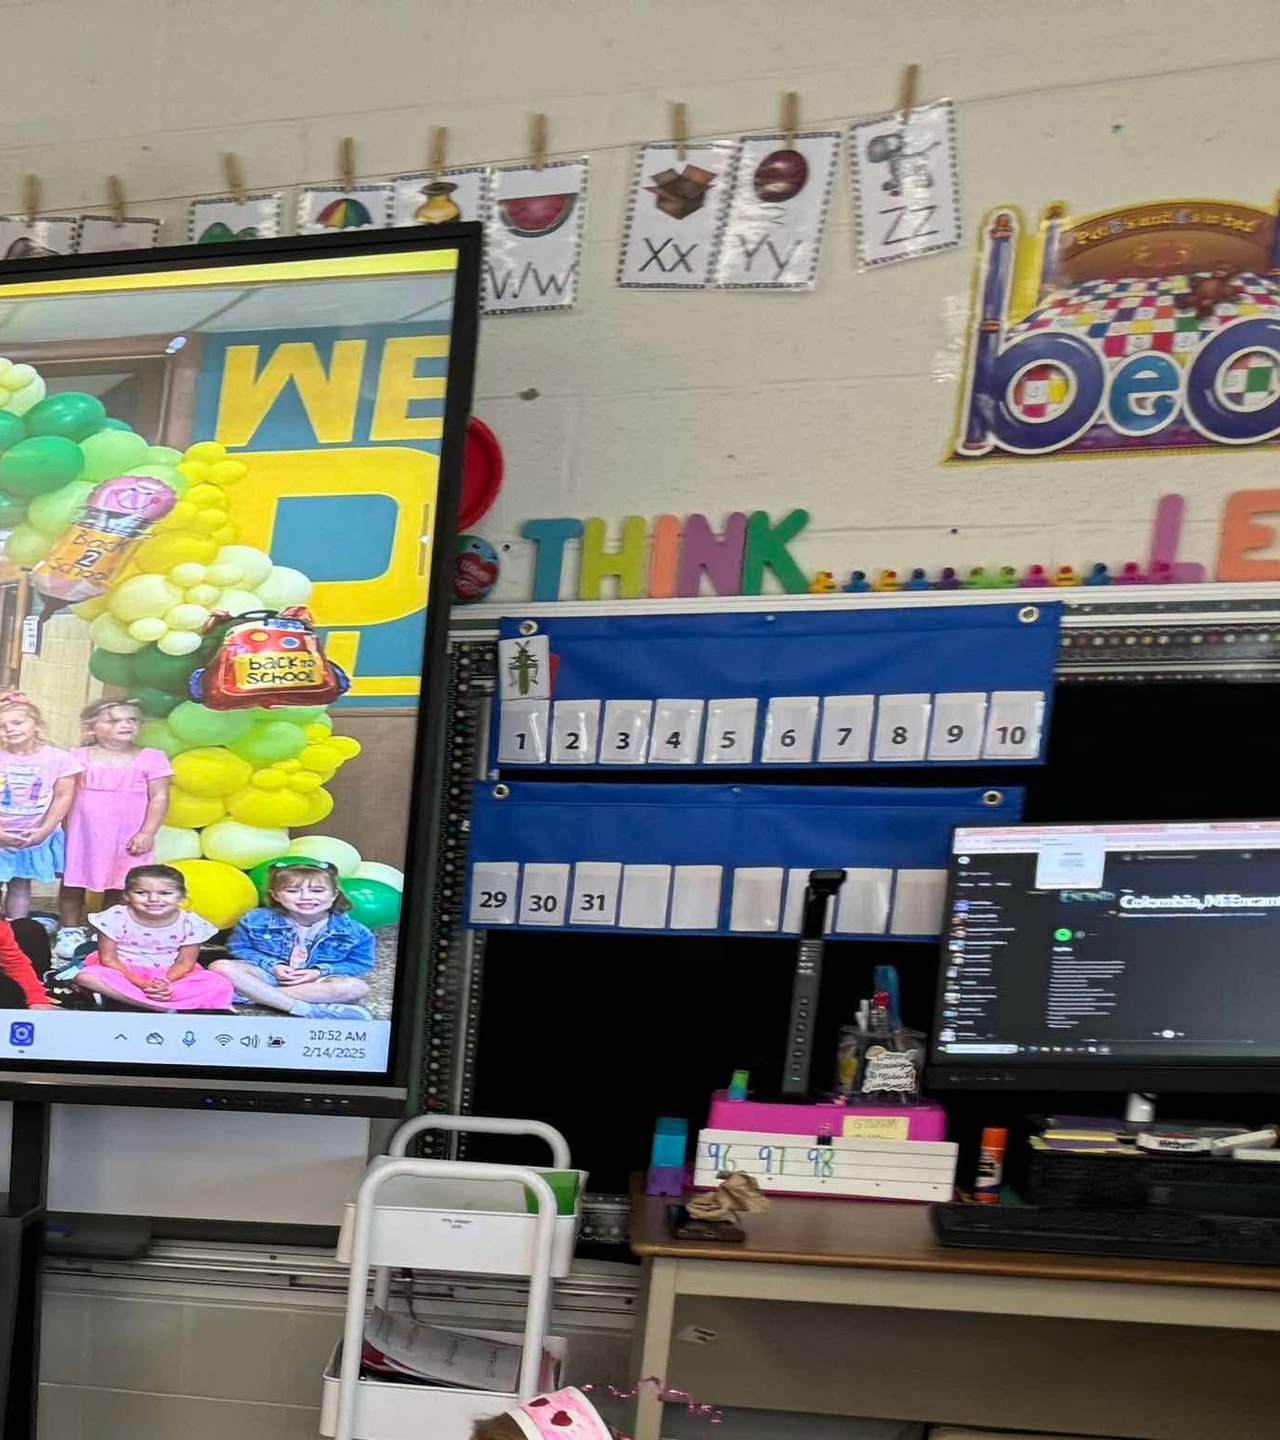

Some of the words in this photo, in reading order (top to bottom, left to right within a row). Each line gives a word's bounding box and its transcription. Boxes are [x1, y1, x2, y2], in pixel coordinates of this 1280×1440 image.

[878, 205, 939, 246] Zz
[639, 237, 698, 272] Xx
[742, 234, 802, 278] Yy
[80, 552, 102, 566] 2
[521, 508, 810, 601] THINK
[515, 732, 527, 751] 1
[566, 732, 581, 751] 2
[615, 732, 631, 751] 3
[665, 731, 682, 750] 4
[721, 730, 737, 750] 5
[781, 730, 797, 748] 6
[837, 728, 853, 747] 7
[891, 727, 909, 746] 8
[946, 725, 963, 744] 9
[997, 726, 1026, 746] 10
[479, 891, 507, 909] 29
[528, 894, 557, 914] 30
[581, 894, 607, 912] 31
[344, 1030, 367, 1043] AM
[706, 1143, 735, 1173] 96
[758, 1144, 786, 1176] 97
[806, 1146, 835, 1179] 98
